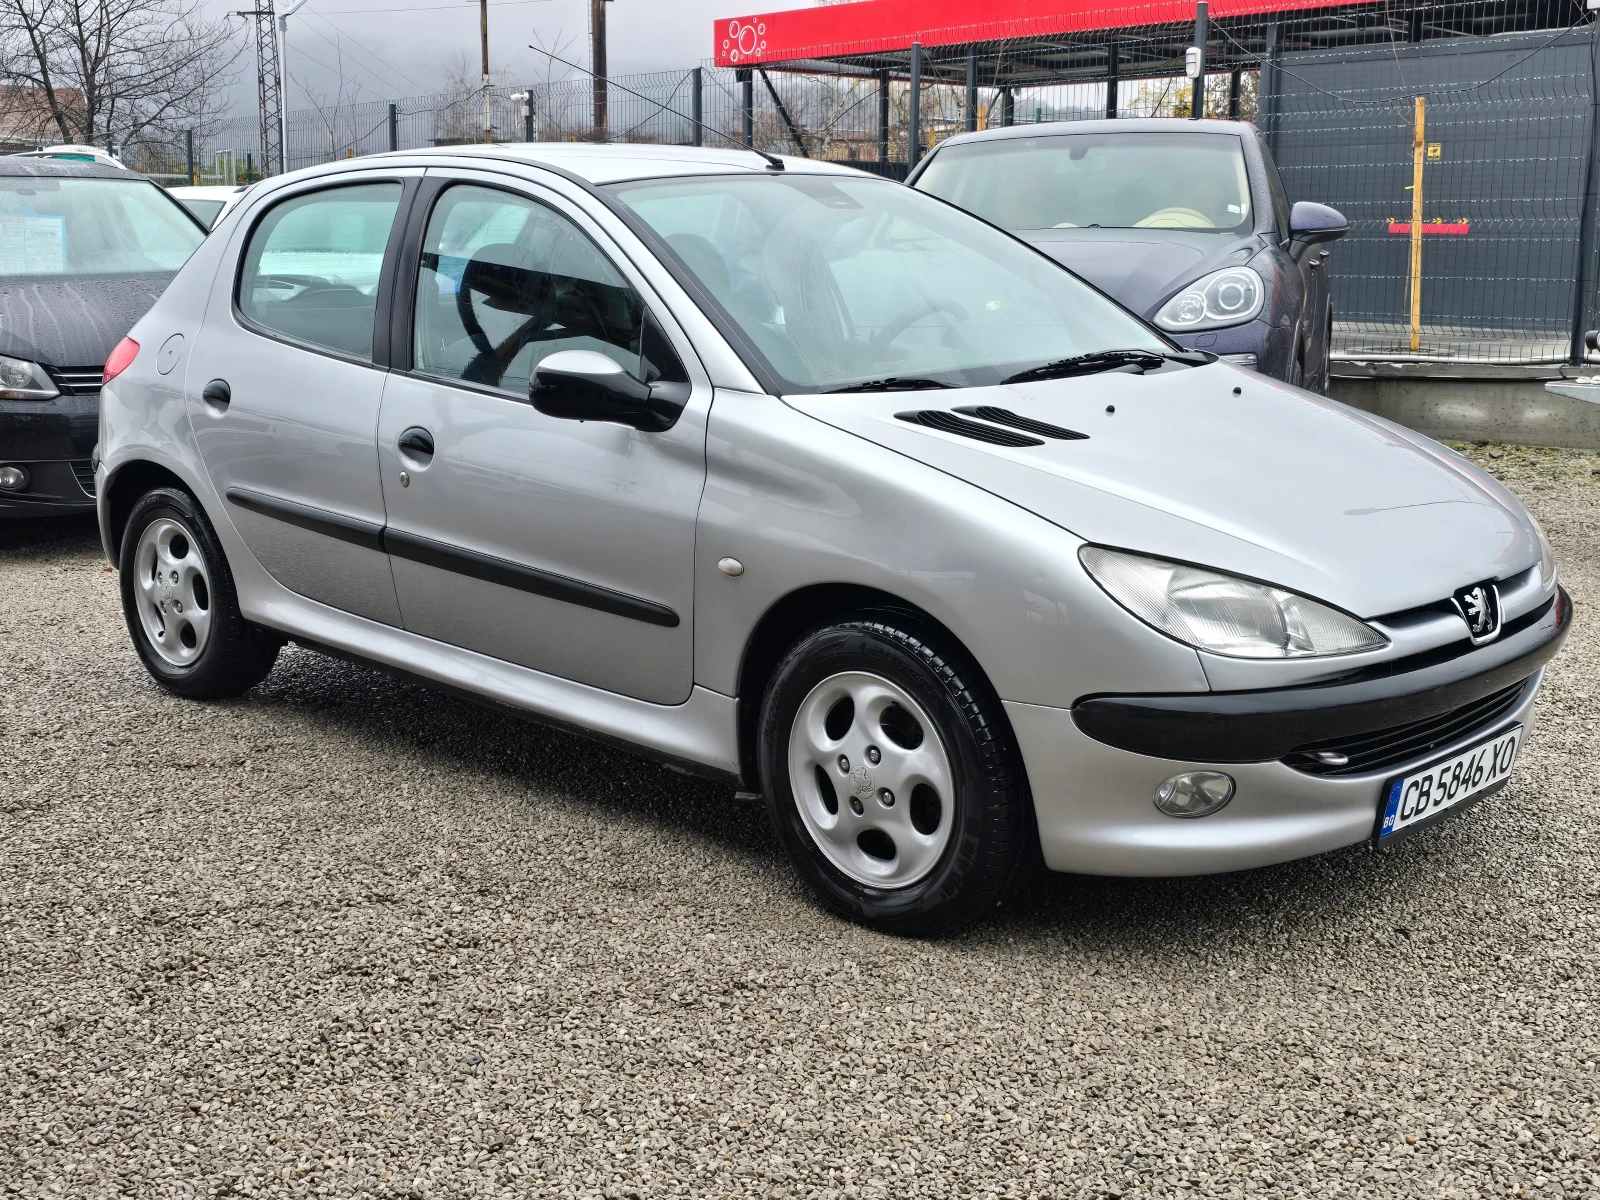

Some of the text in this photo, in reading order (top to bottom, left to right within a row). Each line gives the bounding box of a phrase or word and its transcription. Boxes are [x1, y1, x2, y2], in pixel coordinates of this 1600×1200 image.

[1400, 736, 1516, 821] CB 5846 XO
[1383, 815, 1395, 828] BG
